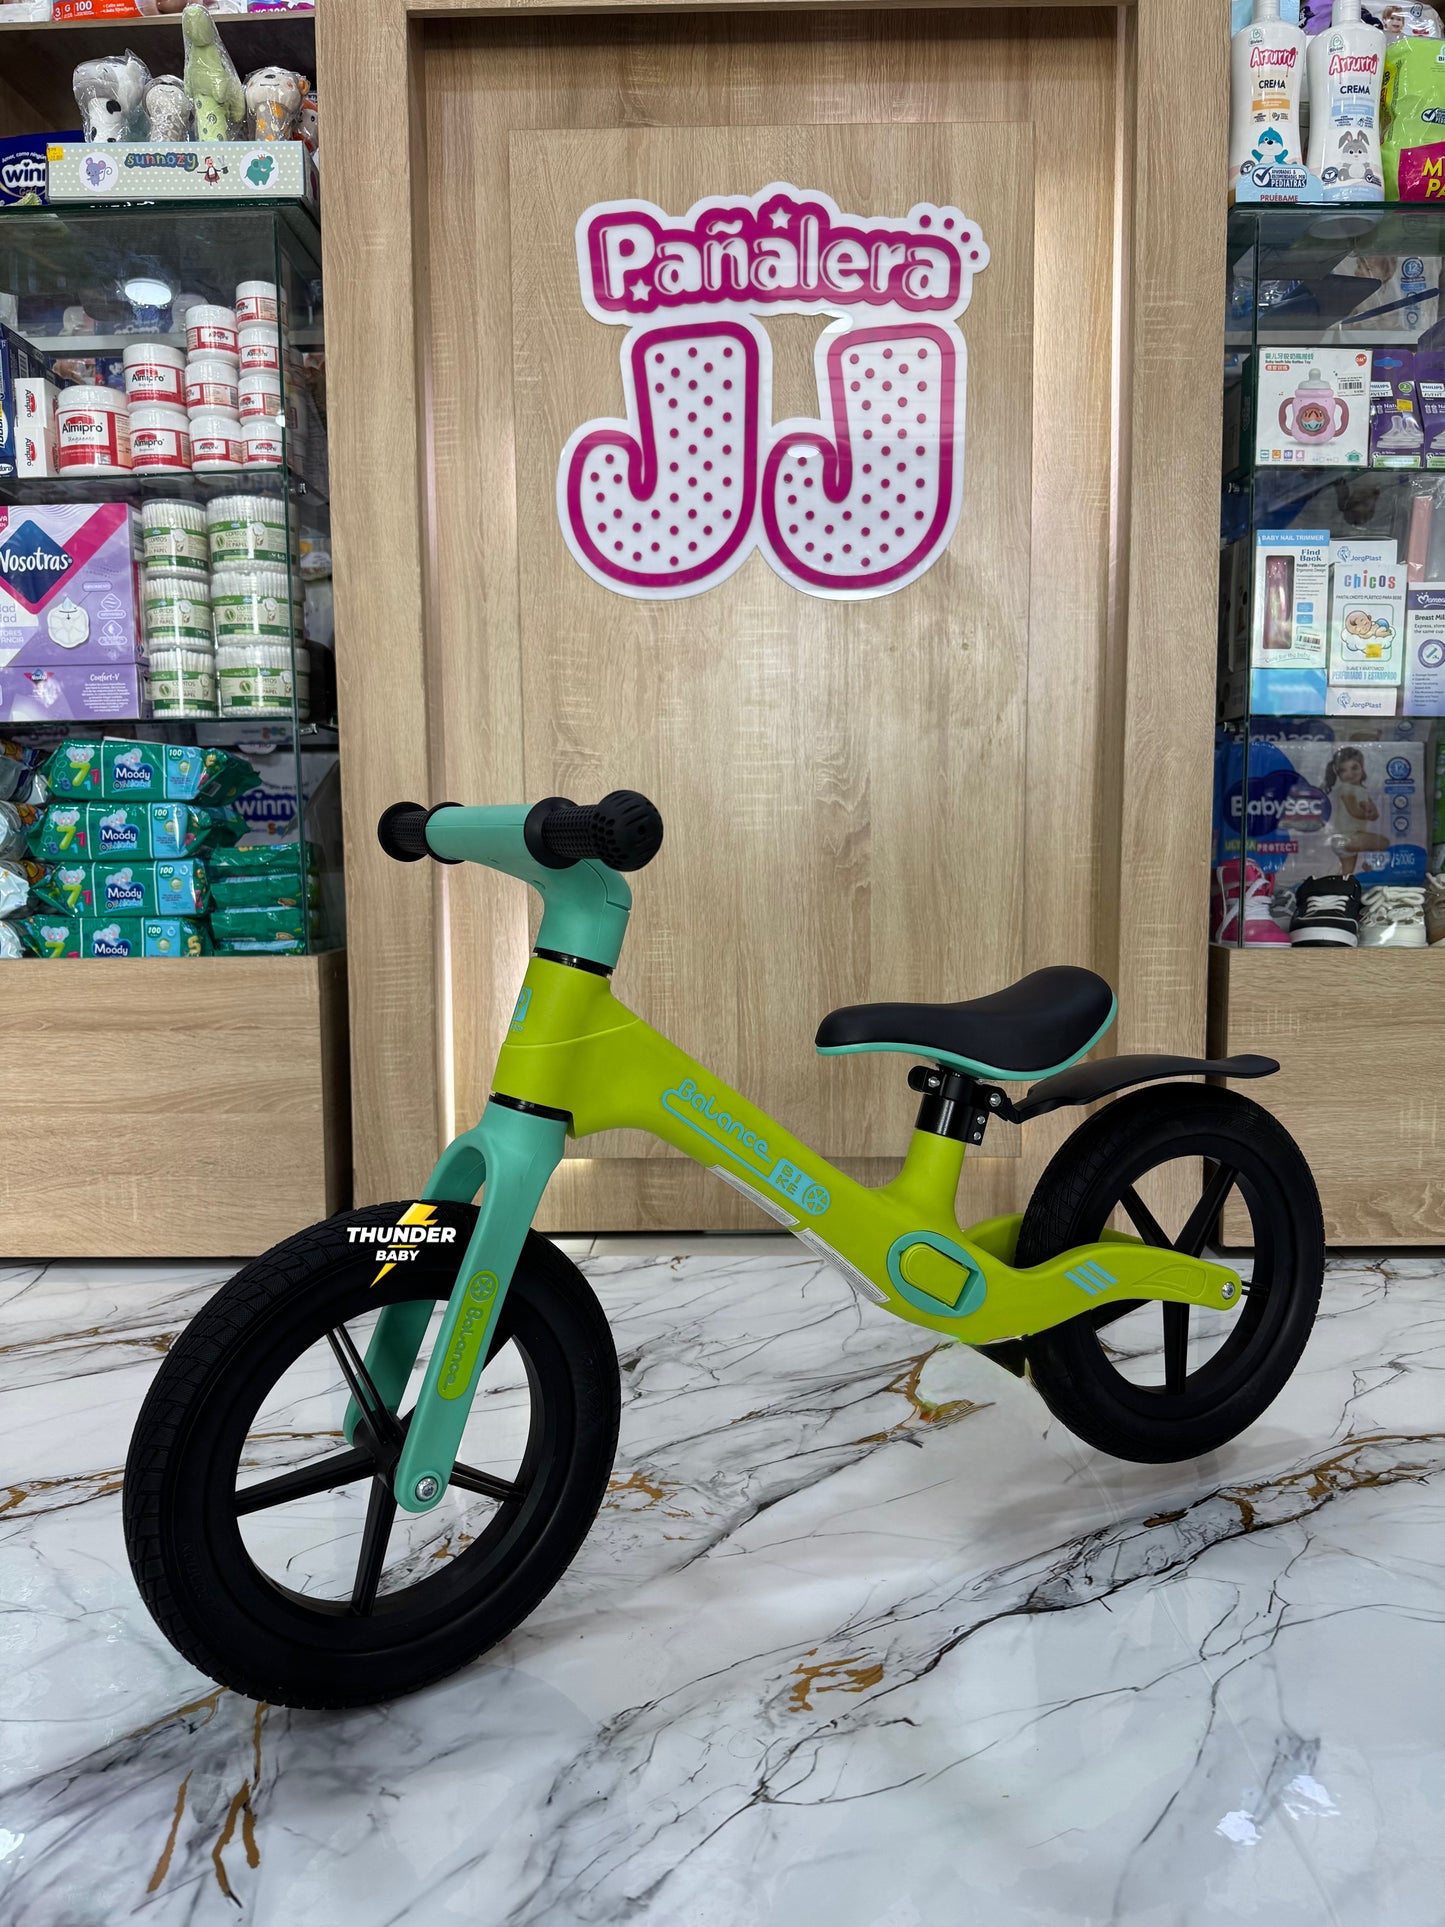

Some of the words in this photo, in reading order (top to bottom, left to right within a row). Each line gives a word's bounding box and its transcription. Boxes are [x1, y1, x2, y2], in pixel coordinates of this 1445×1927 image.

[75, 1, 92, 11] 100
[1259, 80, 1286, 89] CREMA
[1340, 85, 1370, 95] CREMA
[127, 154, 196, 170] sunnozy
[1271, 180, 1306, 188] PEDIATRAS
[1260, 193, 1299, 202] PRUÉBAME
[601, 212, 951, 301] Pañalera
[132, 374, 164, 382] Almipro
[62, 422, 103, 435] Almipro
[134, 439, 164, 448] Almipro
[0, 547, 68, 573] Nosotras
[1344, 569, 1396, 590] chicos
[169, 749, 182, 757] 100
[115, 768, 150, 780] Moody
[101, 829, 136, 841] Moody
[1257, 843, 1298, 852] PROTECT
[160, 866, 174, 874] 100
[107, 887, 142, 899] Moody
[148, 926, 162, 934] 100
[94, 943, 129, 956] Moody
[676, 1077, 772, 1164] Balance
[441, 1307, 484, 1390] Balance
